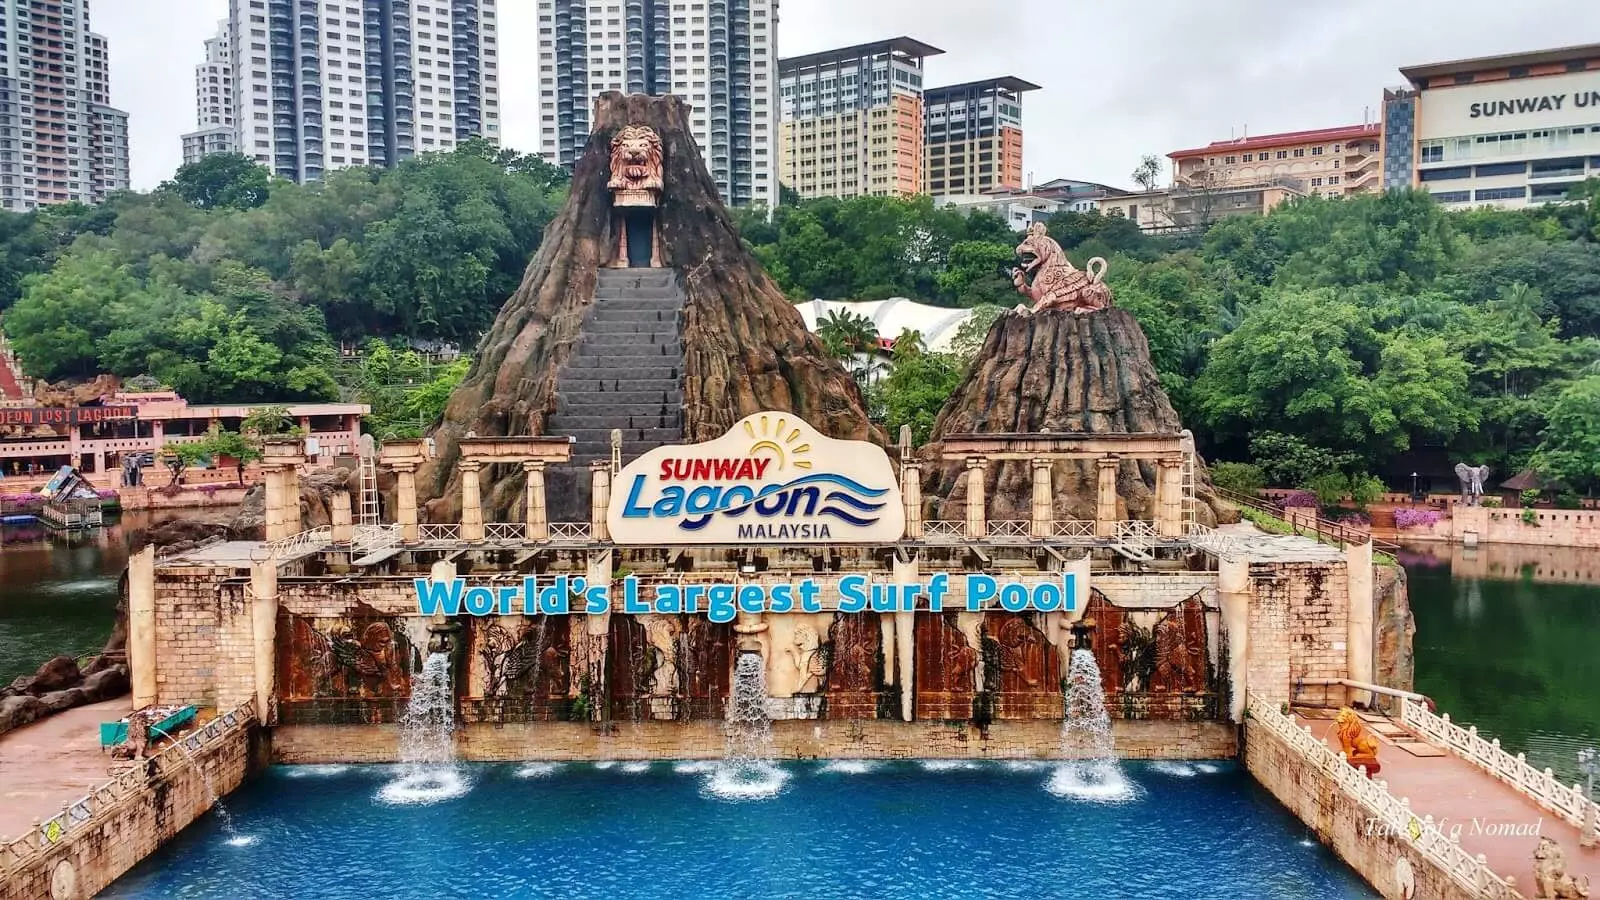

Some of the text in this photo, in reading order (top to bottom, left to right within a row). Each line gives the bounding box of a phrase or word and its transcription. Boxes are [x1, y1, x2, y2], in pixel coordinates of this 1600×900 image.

[1470, 94, 1566, 118] SUNWAY
[40, 409, 71, 424] LOST
[77, 407, 131, 422] LAGOON
[659, 457, 772, 481] SUNWAY
[622, 473, 821, 531] Lagoon
[738, 523, 831, 539] MALAYSIA
[413, 571, 1077, 623] World's Largest Surf Pool
